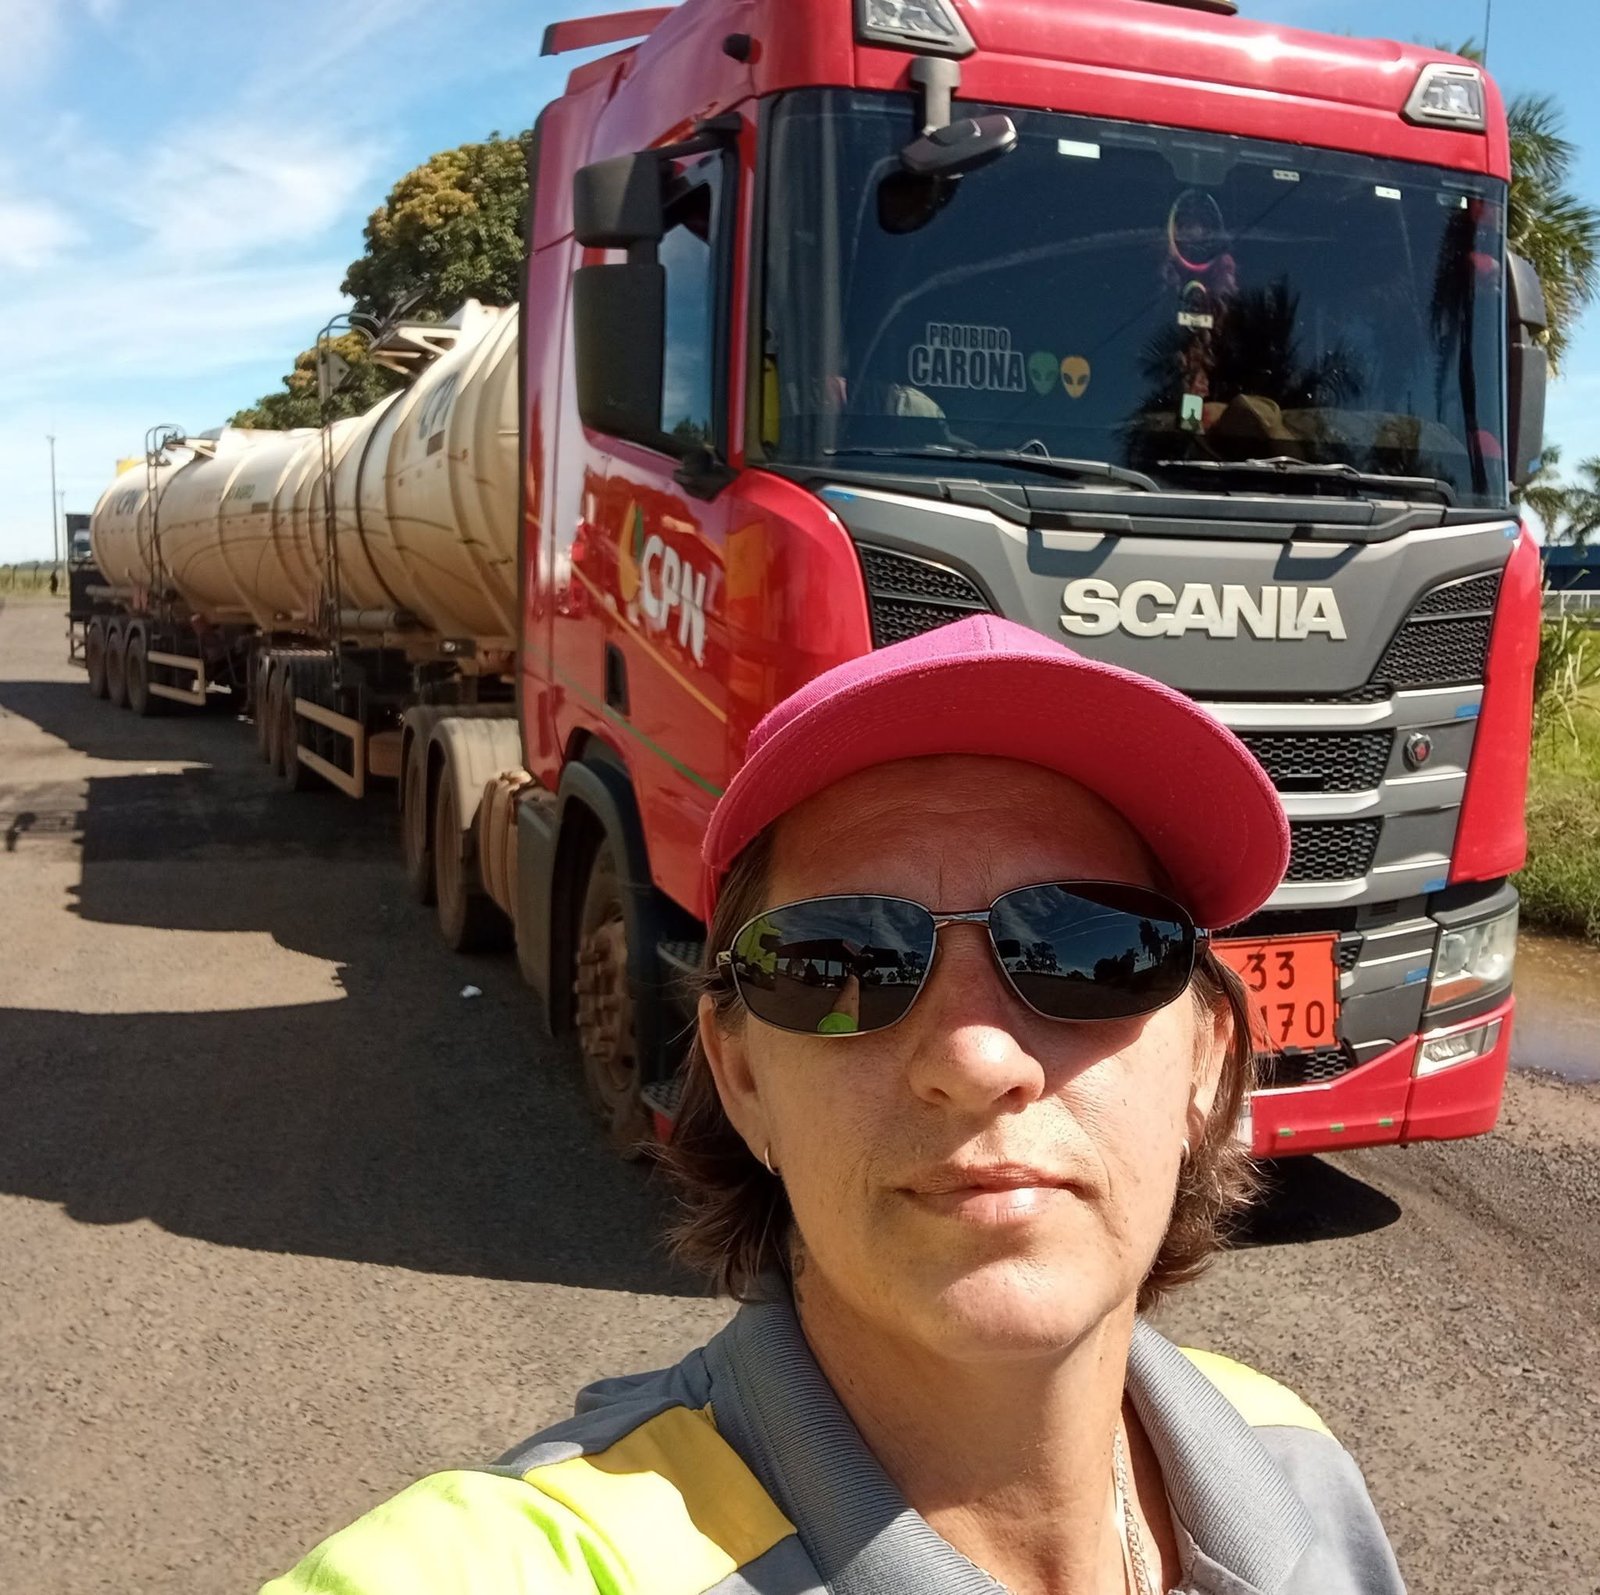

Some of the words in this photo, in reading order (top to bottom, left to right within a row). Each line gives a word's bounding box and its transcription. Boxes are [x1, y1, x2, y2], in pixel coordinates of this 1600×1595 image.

[927, 324, 1009, 351] PROIBIDO
[909, 346, 1026, 391] CARONA
[641, 535, 706, 668] CPN
[1060, 578, 1347, 640] SCANIA
[1246, 951, 1295, 992] 33
